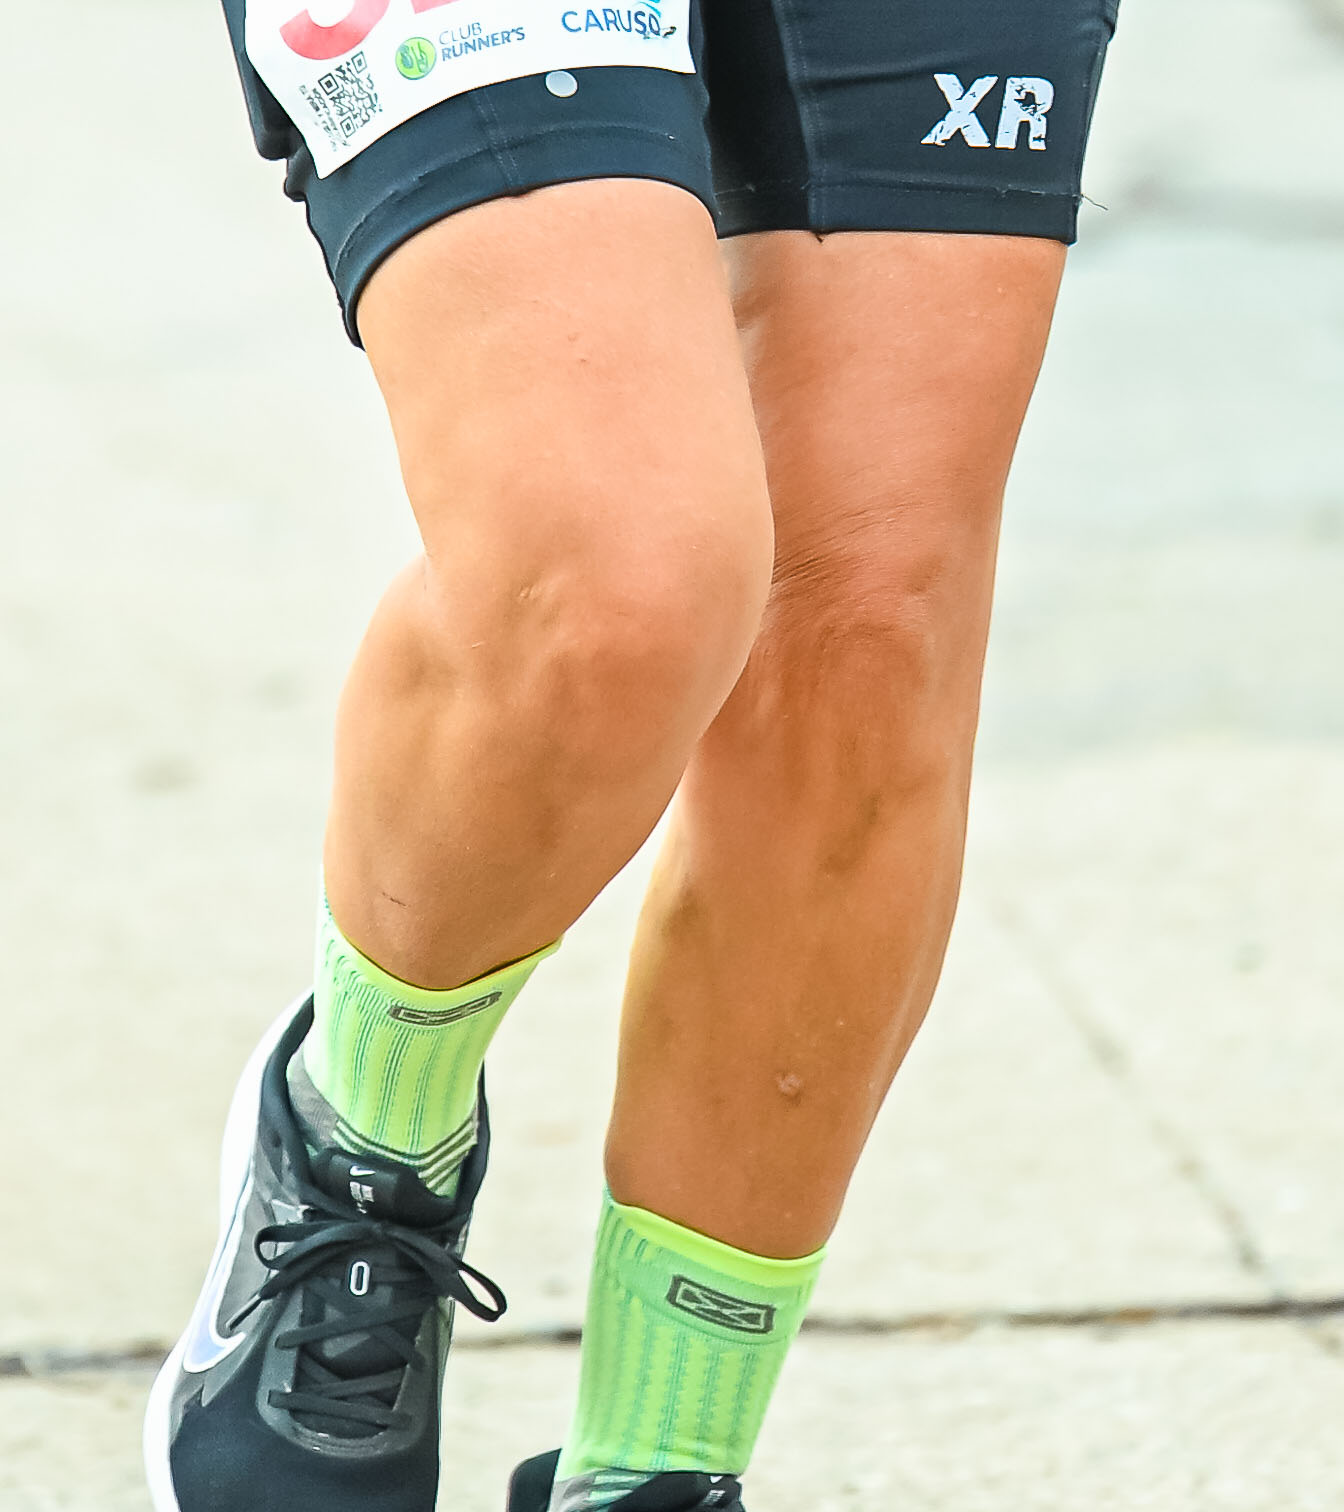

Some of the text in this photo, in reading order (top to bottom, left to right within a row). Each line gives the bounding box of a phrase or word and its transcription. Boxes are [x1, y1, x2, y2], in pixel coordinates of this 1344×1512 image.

[439, 22, 482, 45] CLUB
[562, 8, 661, 36] CARUSO
[442, 27, 525, 61] RUNNER'S
[921, 73, 1054, 150] XR
